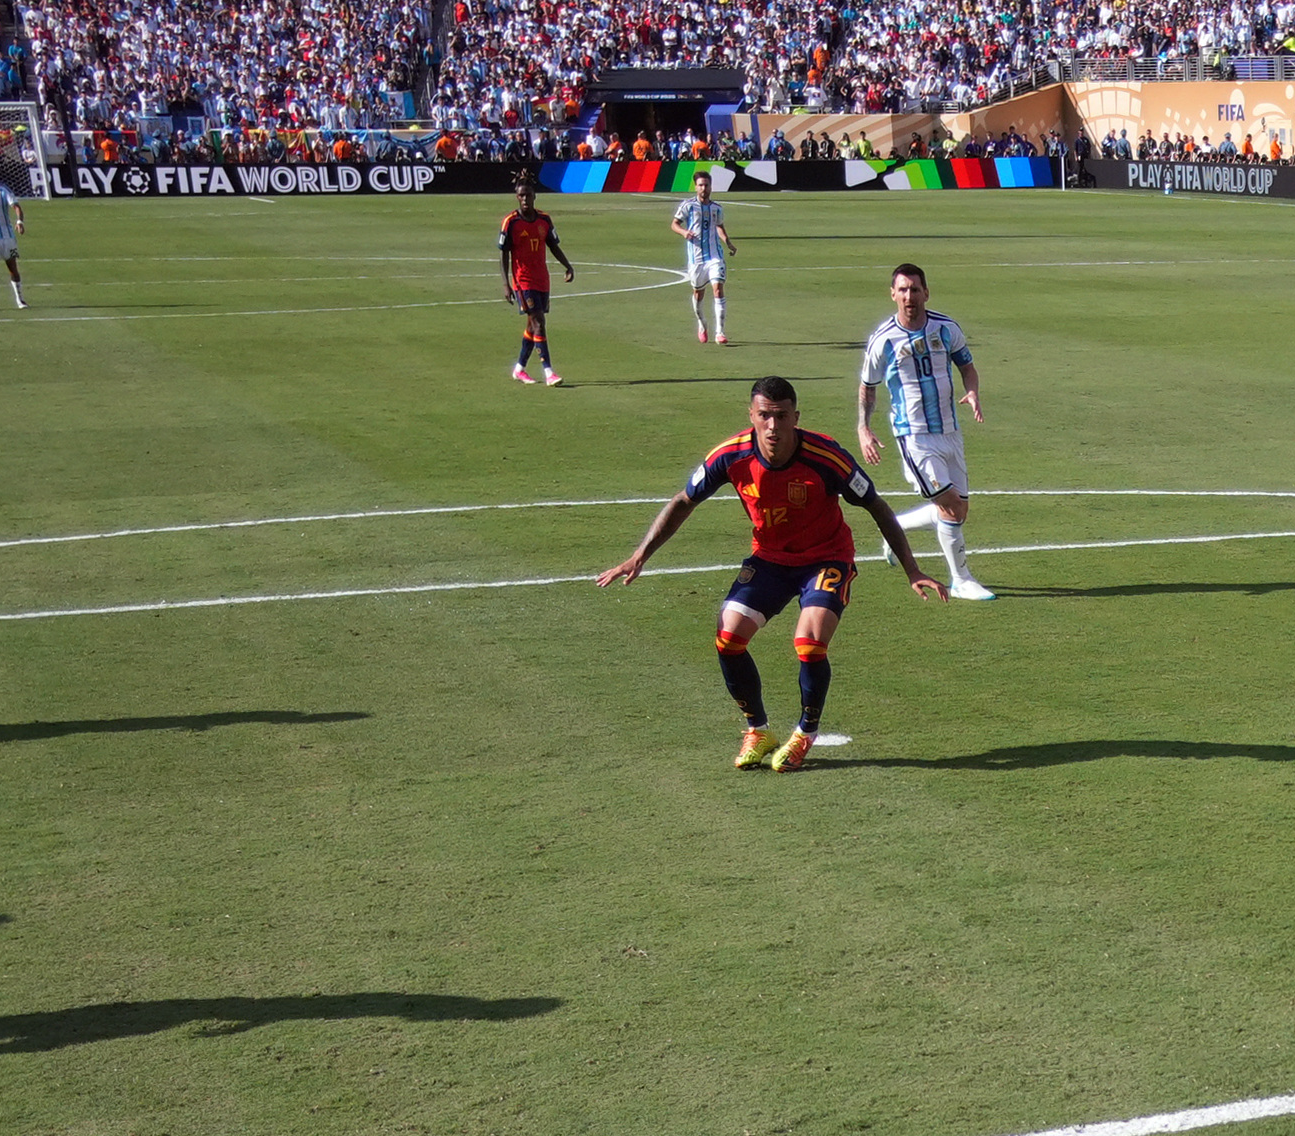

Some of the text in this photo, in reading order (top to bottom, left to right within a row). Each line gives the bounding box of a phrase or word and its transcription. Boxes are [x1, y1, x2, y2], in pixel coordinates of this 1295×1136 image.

[1217, 104, 1245, 122] FIFA
[29, 166, 118, 197] PLAY
[156, 166, 235, 195] FIFA
[237, 165, 362, 194] WORLD
[1128, 163, 1161, 188] PLAY
[1175, 164, 1201, 191] FIFA
[1202, 165, 1246, 194] WORLD
[529, 238, 540, 252] 17
[762, 507, 789, 528] 12
[814, 566, 842, 594] 12
